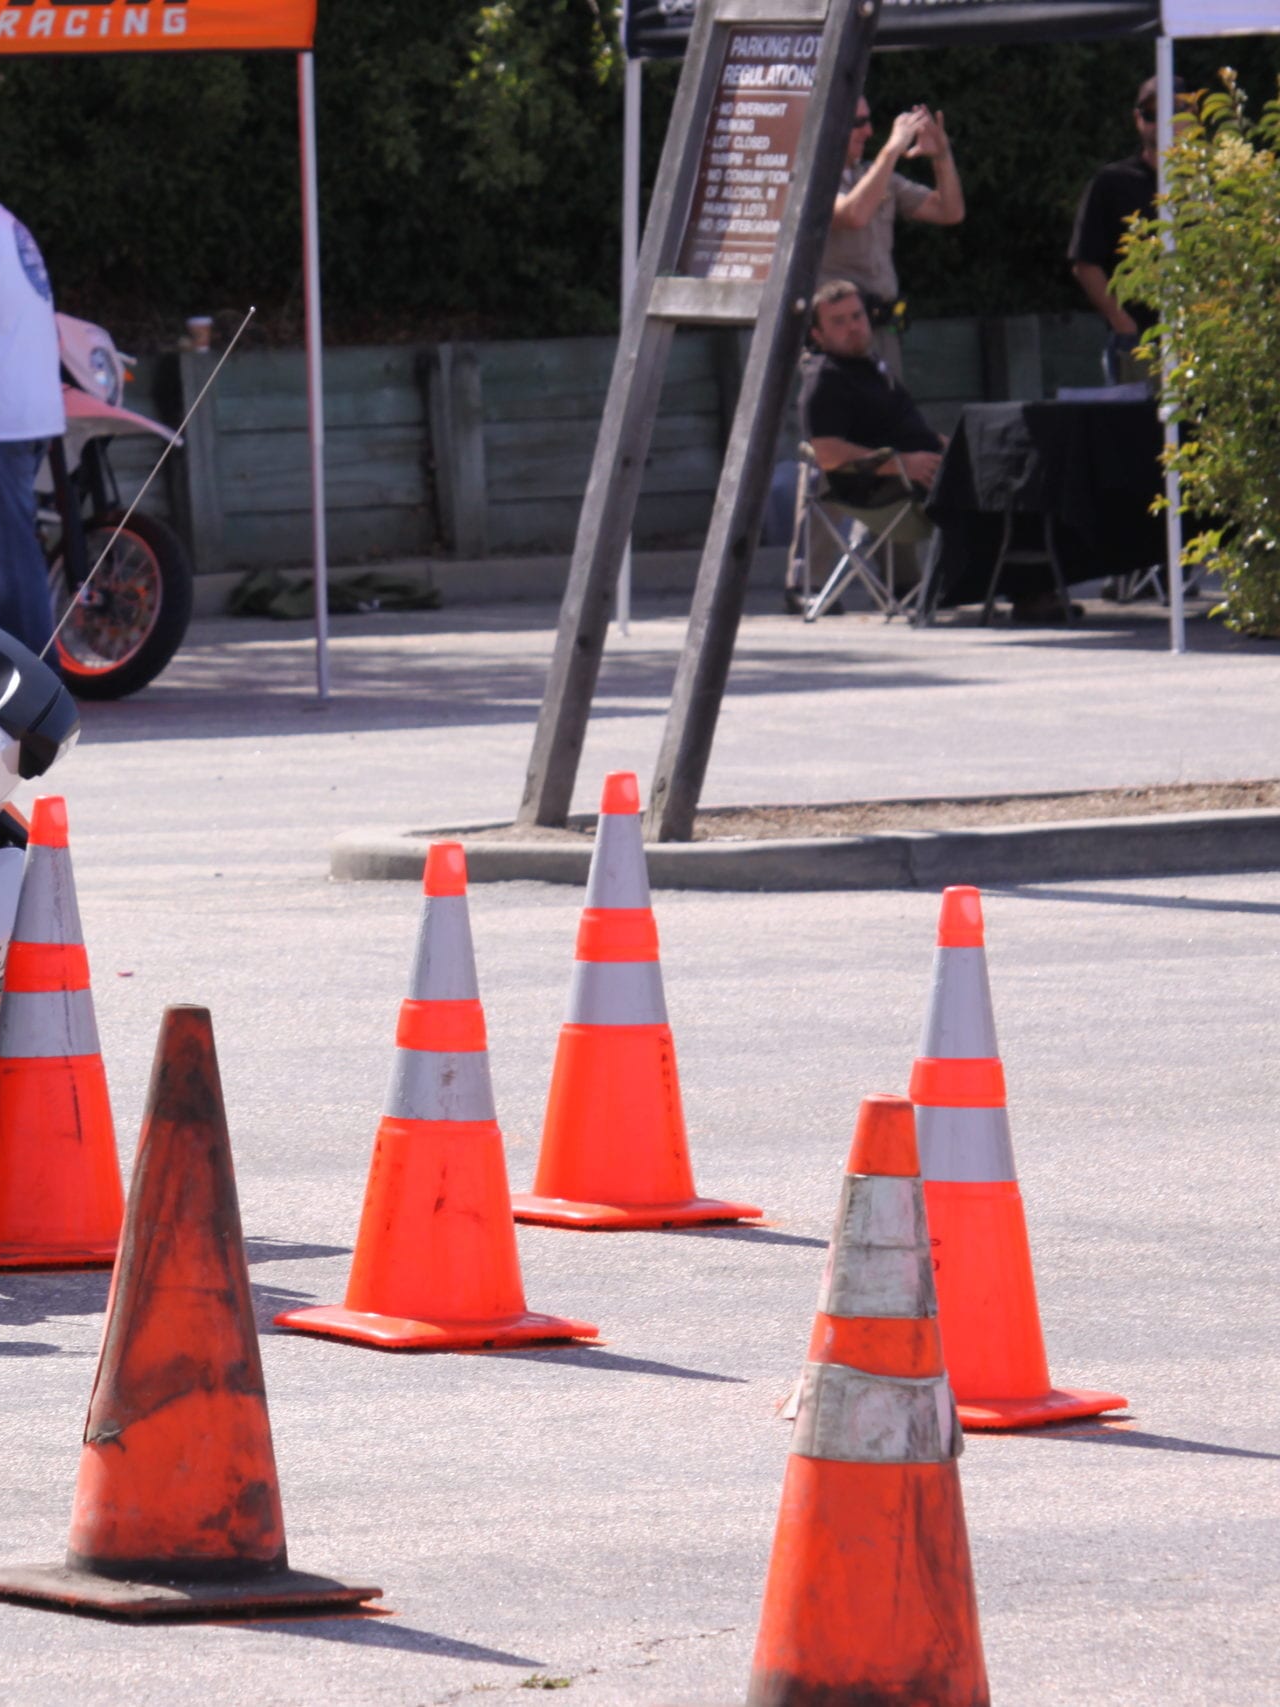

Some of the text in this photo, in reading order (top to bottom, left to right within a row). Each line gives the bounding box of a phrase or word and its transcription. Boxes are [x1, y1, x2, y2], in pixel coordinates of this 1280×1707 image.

[730, 35, 825, 57] PARKING LOT
[719, 102, 788, 117] NO OVERNIGHT
[712, 135, 770, 150] LOT CLOSED
